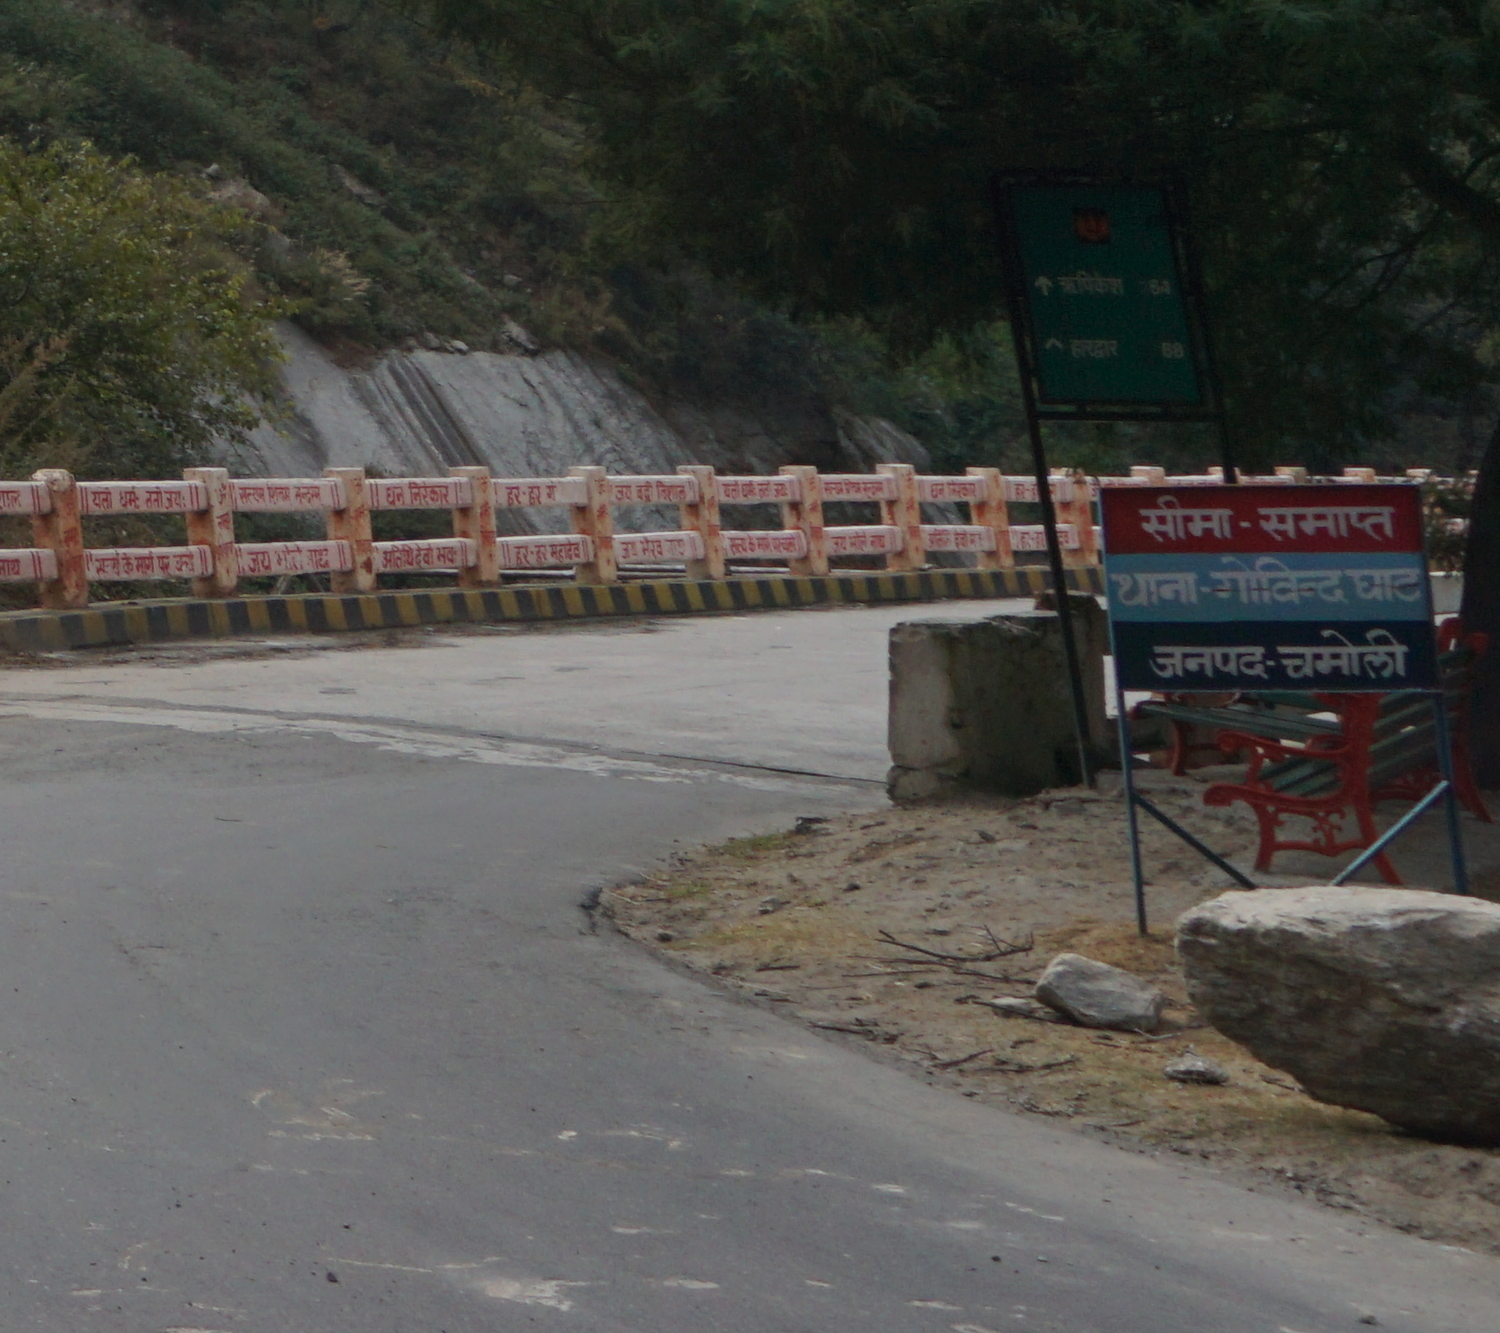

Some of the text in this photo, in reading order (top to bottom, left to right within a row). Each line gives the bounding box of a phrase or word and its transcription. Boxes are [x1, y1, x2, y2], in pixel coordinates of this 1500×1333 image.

[1138, 494, 1396, 542] सीमा समाप्त
[1343, 567, 1422, 603] घाट
